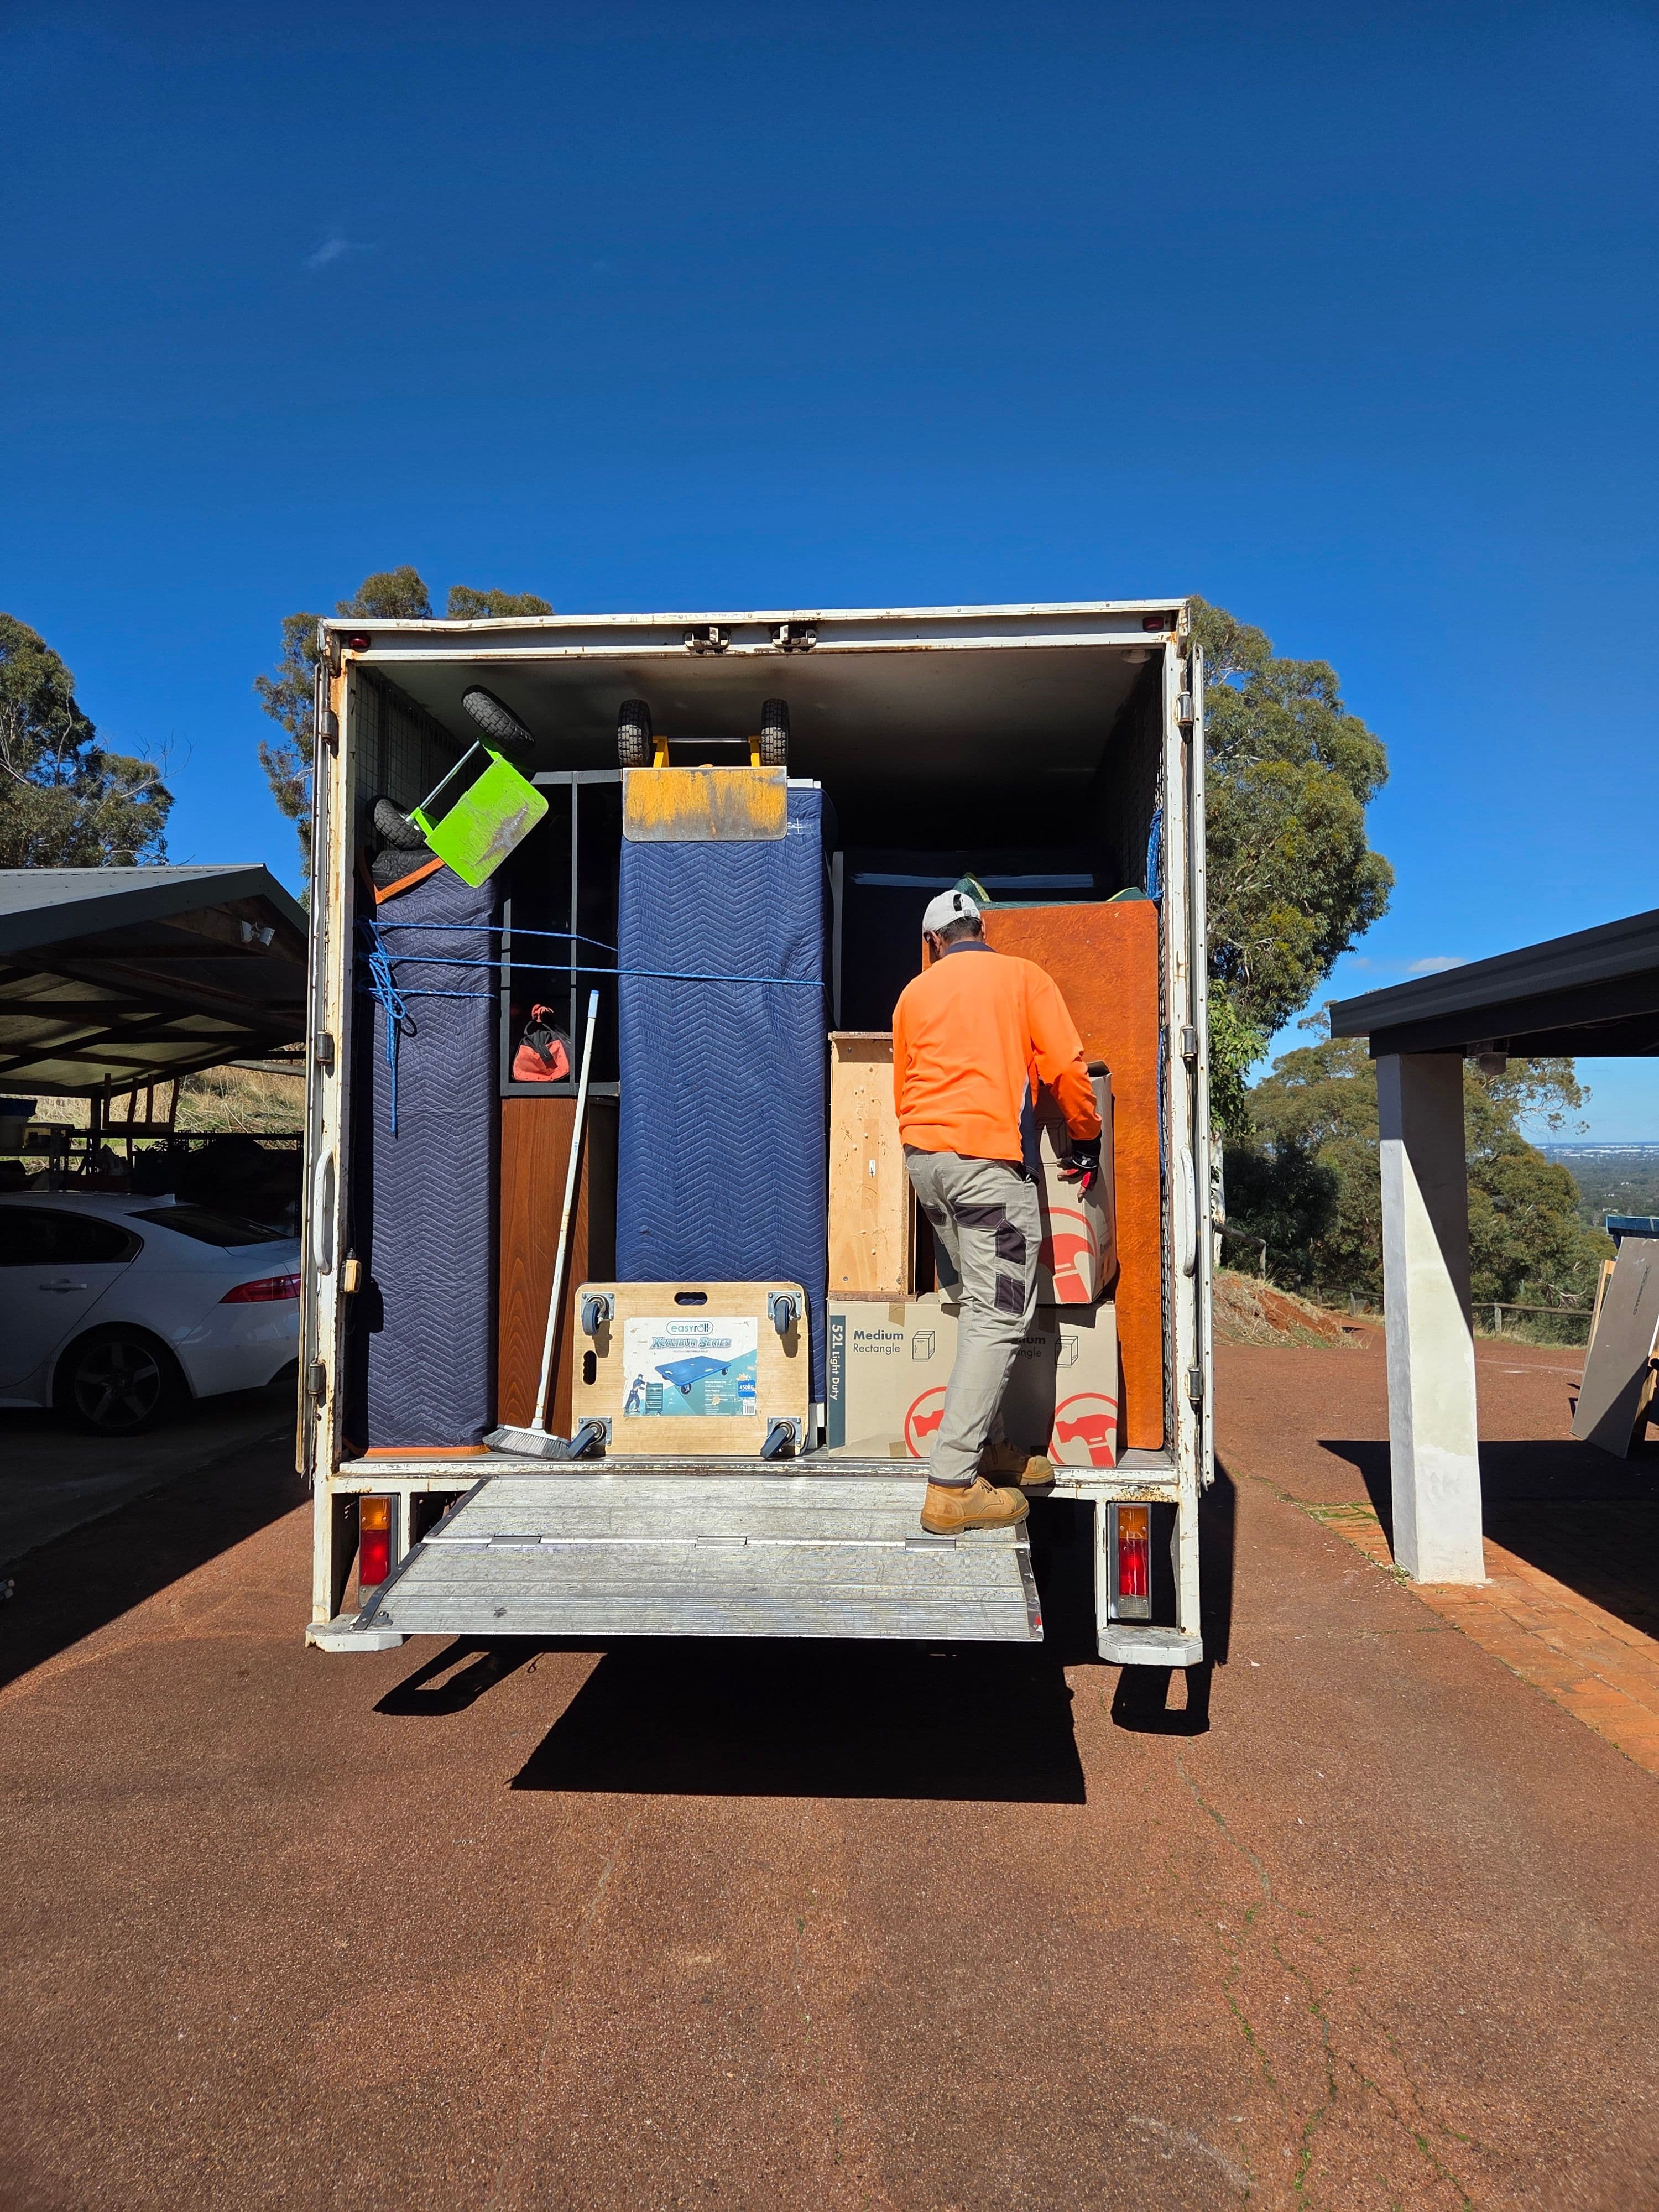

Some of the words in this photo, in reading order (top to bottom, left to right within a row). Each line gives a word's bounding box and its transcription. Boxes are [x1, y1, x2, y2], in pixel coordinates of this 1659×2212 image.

[832, 1324, 843, 1349] 52L
[853, 1329, 904, 1340] Medium
[853, 1343, 901, 1355] Rectangle
[830, 1351, 841, 1375] Light
[830, 1378, 840, 1401] Duty
